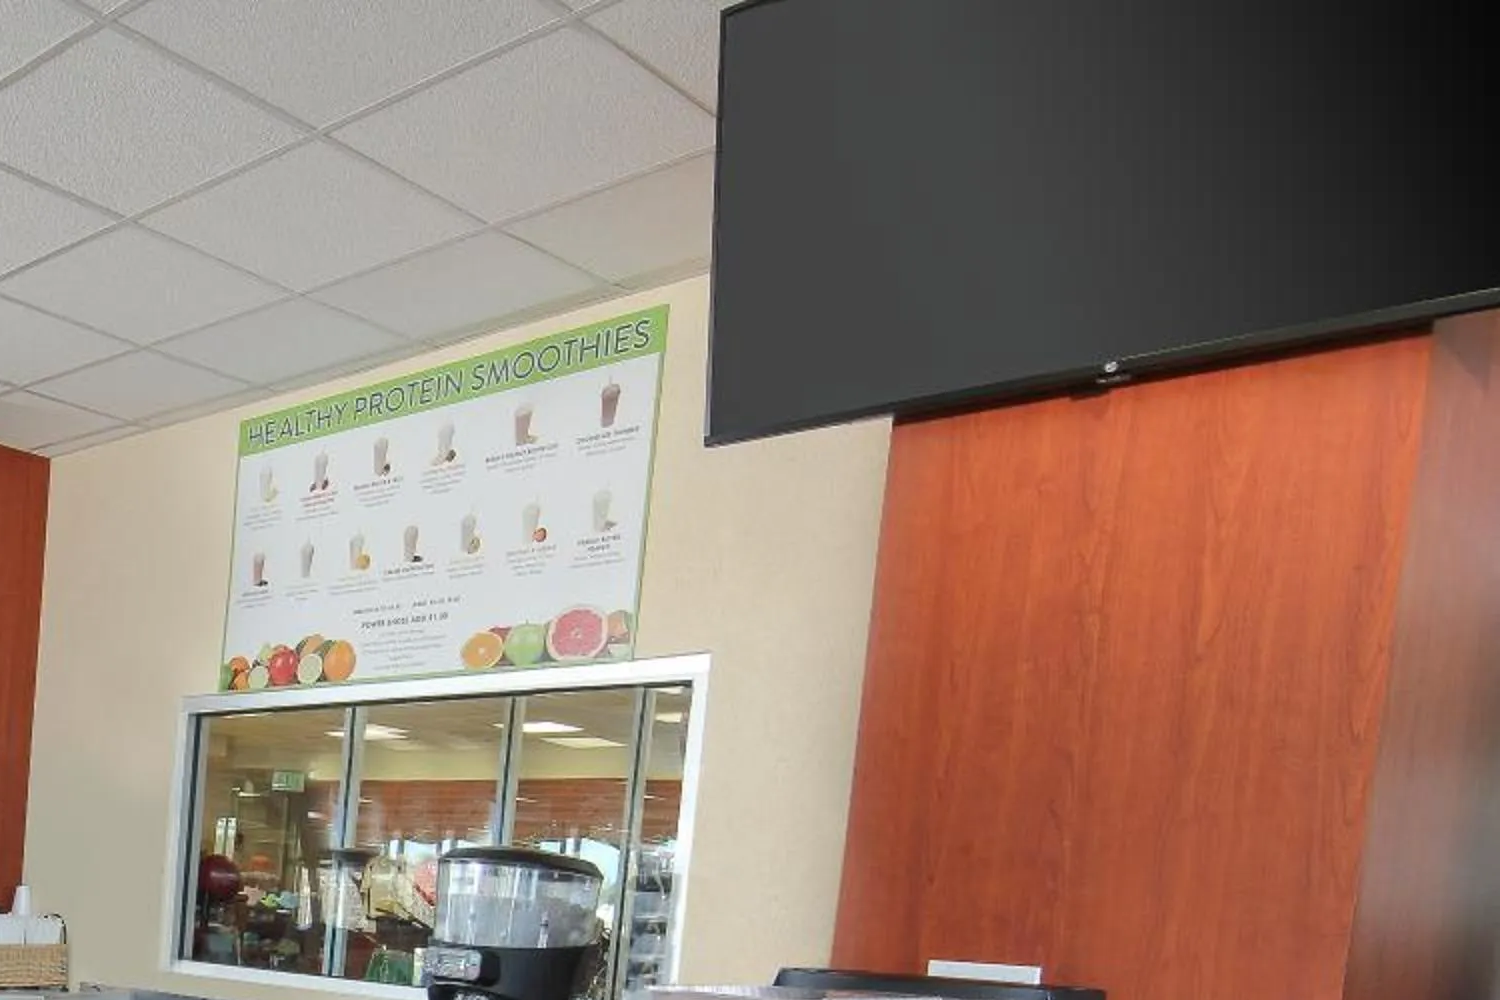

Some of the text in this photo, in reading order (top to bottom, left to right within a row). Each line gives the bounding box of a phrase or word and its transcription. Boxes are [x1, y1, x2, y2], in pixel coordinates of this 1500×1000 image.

[250, 319, 650, 444] HEALTHY PROTEIN SMOOTHIES
